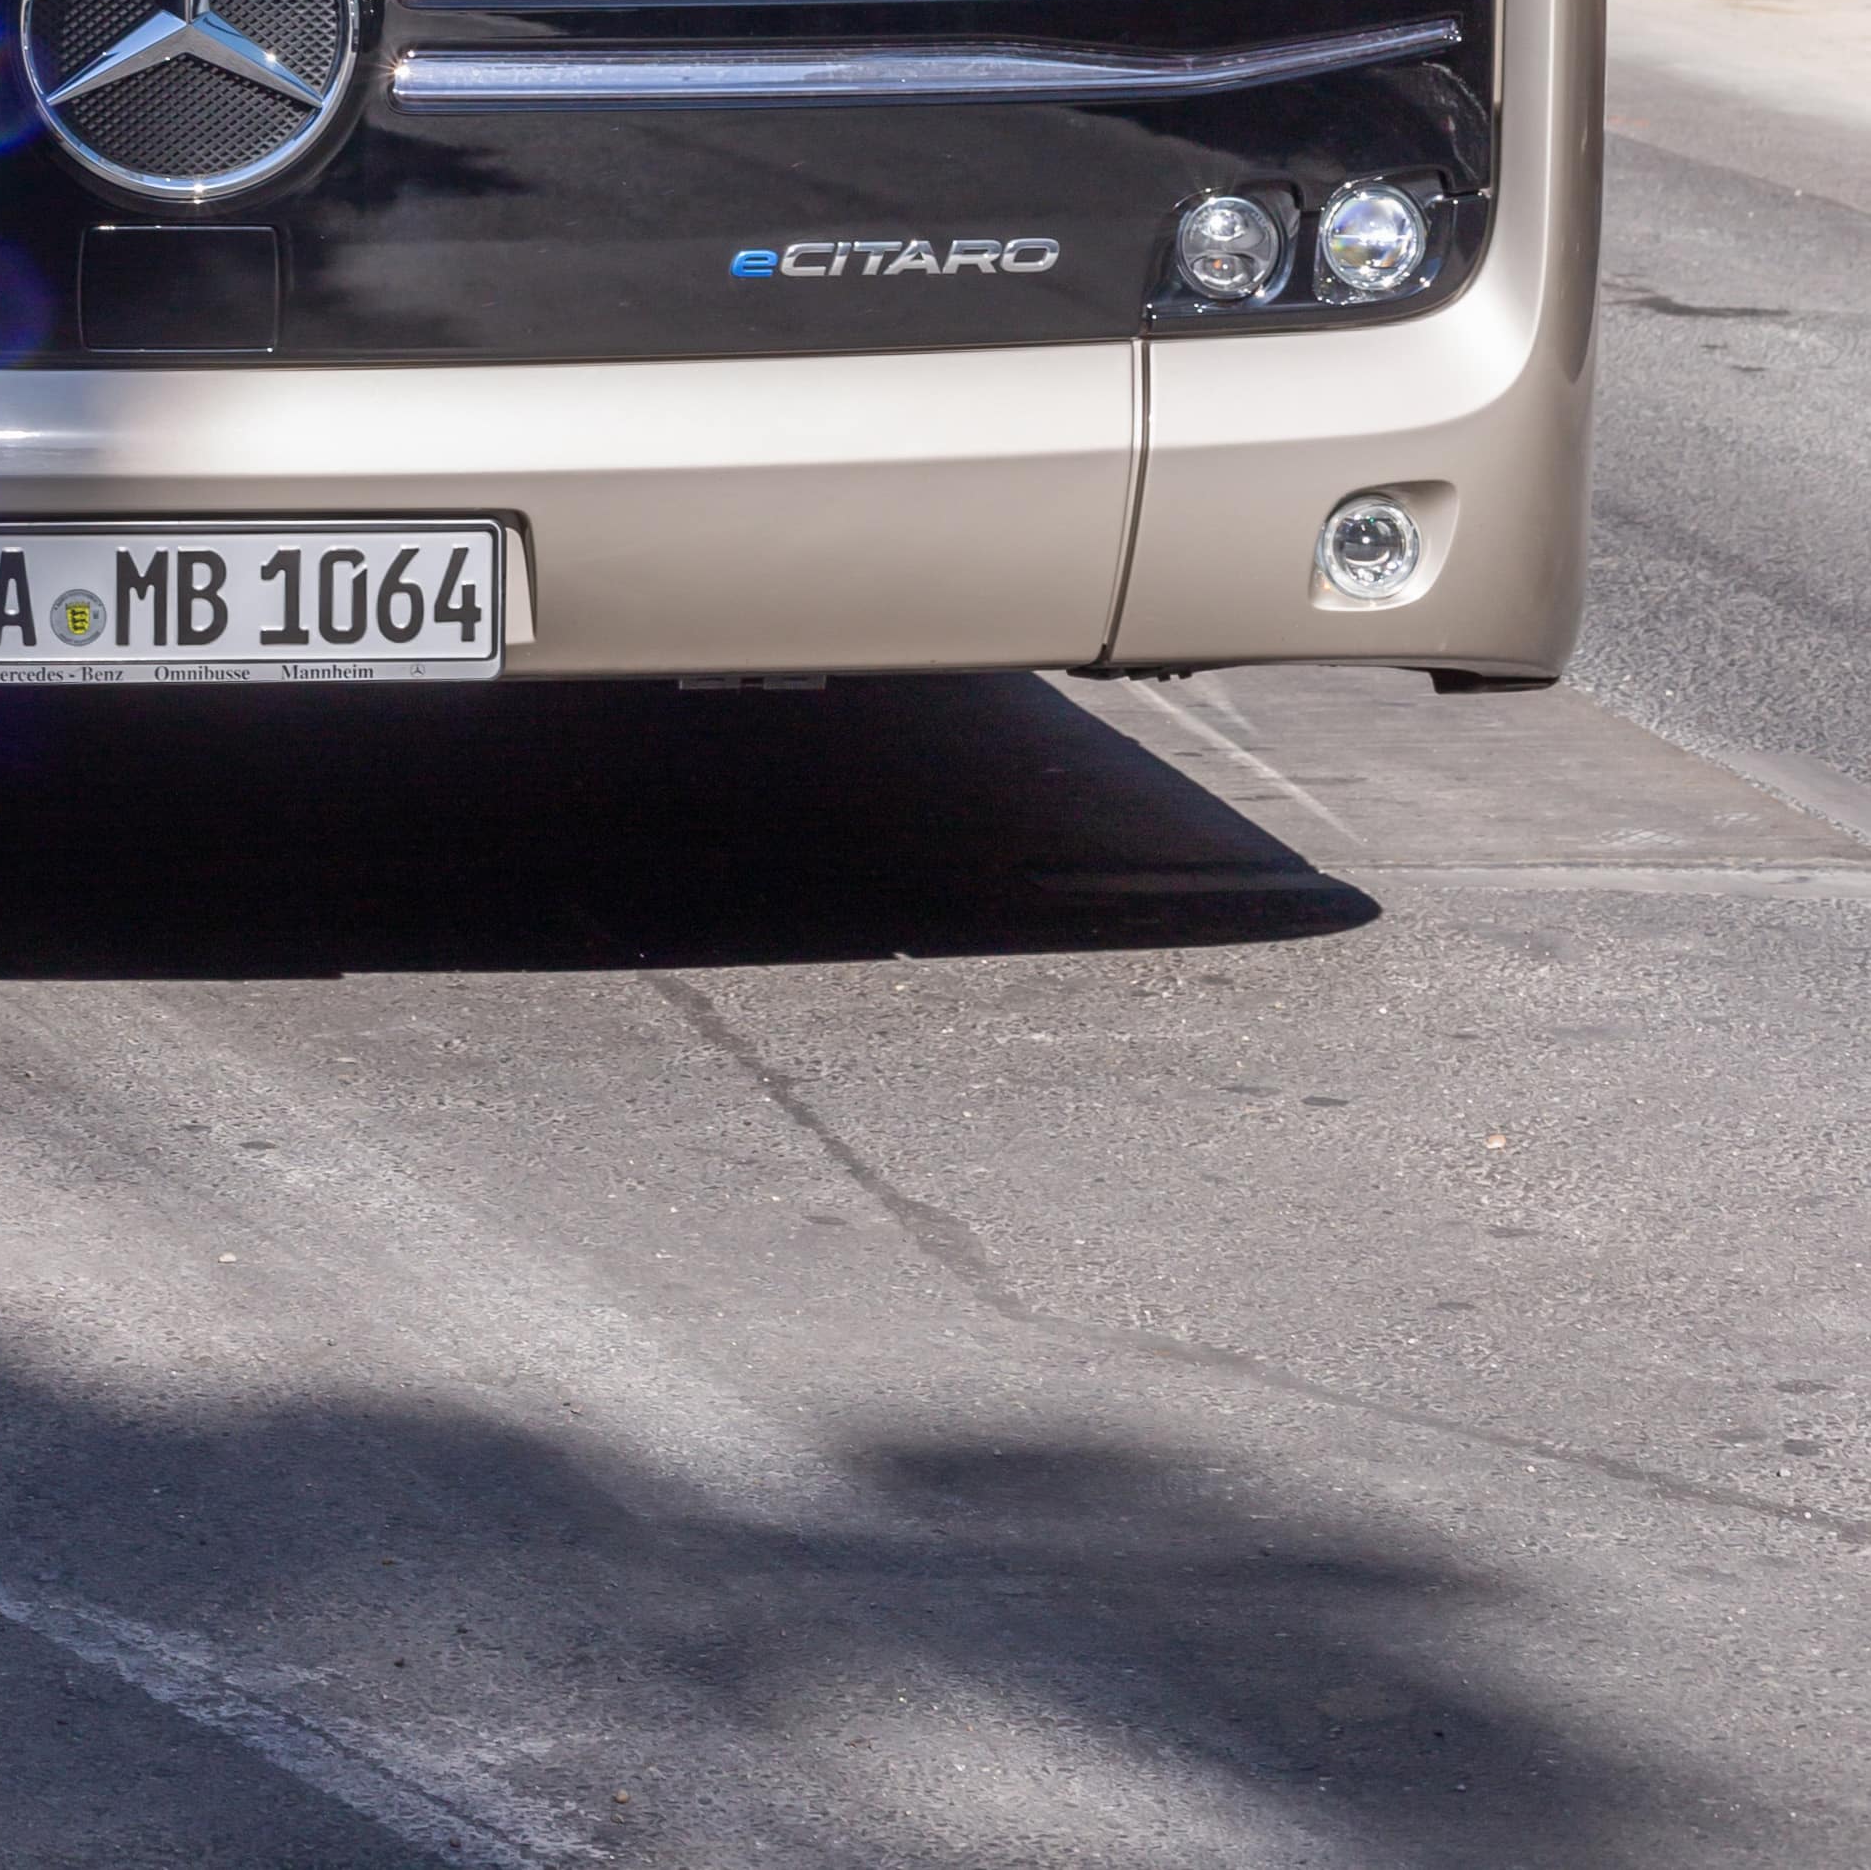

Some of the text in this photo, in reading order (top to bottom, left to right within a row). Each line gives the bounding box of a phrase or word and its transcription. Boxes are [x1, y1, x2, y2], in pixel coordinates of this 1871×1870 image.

[731, 238, 1060, 278] eCITARO
[115, 546, 228, 647] MB
[260, 546, 482, 646] 1064
[81, 665, 124, 682] Benz
[154, 664, 251, 682] Omnibusse
[281, 663, 374, 680] Mannheim
